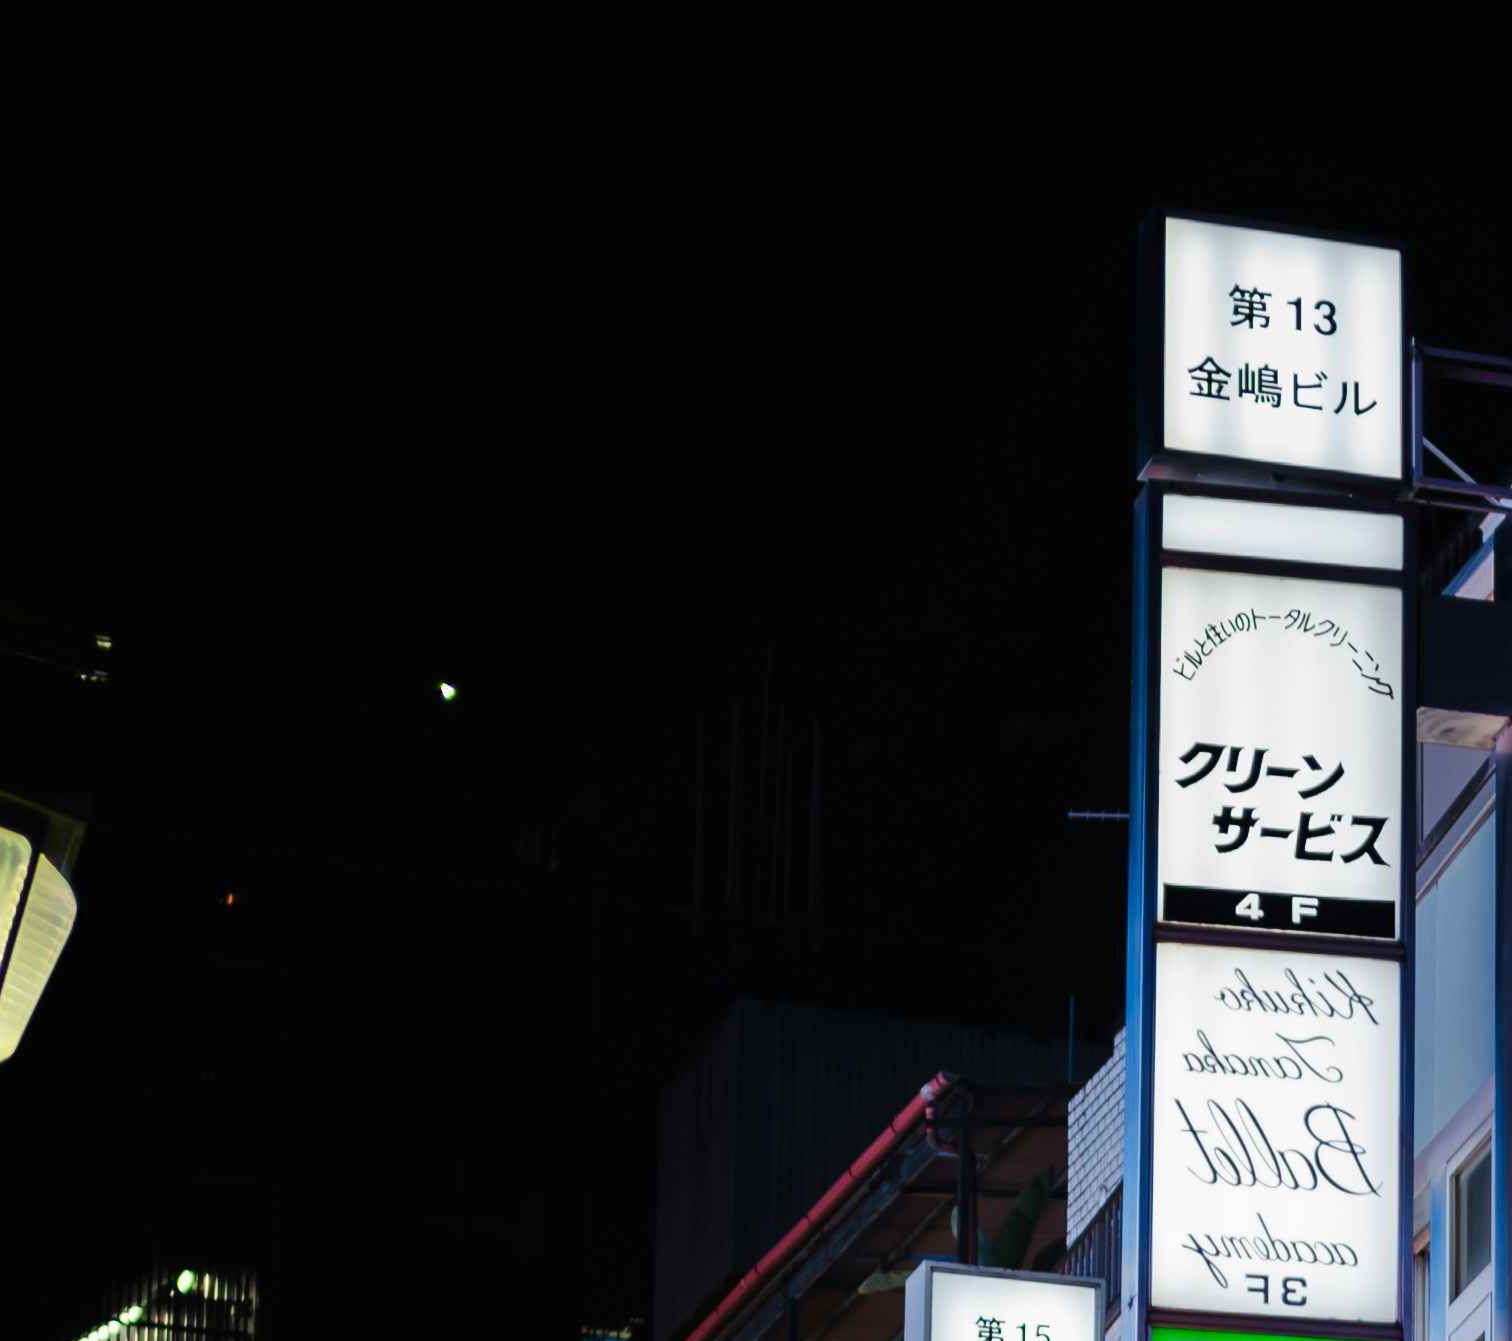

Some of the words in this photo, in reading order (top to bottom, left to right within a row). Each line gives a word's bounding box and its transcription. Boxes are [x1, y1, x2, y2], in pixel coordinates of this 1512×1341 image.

[1228, 284, 1271, 330] 第
[1287, 296, 1338, 338] 13
[1187, 356, 1378, 418] 金嶋ビル
[1175, 742, 1345, 800] クリーン
[1211, 806, 1391, 868] サービス
